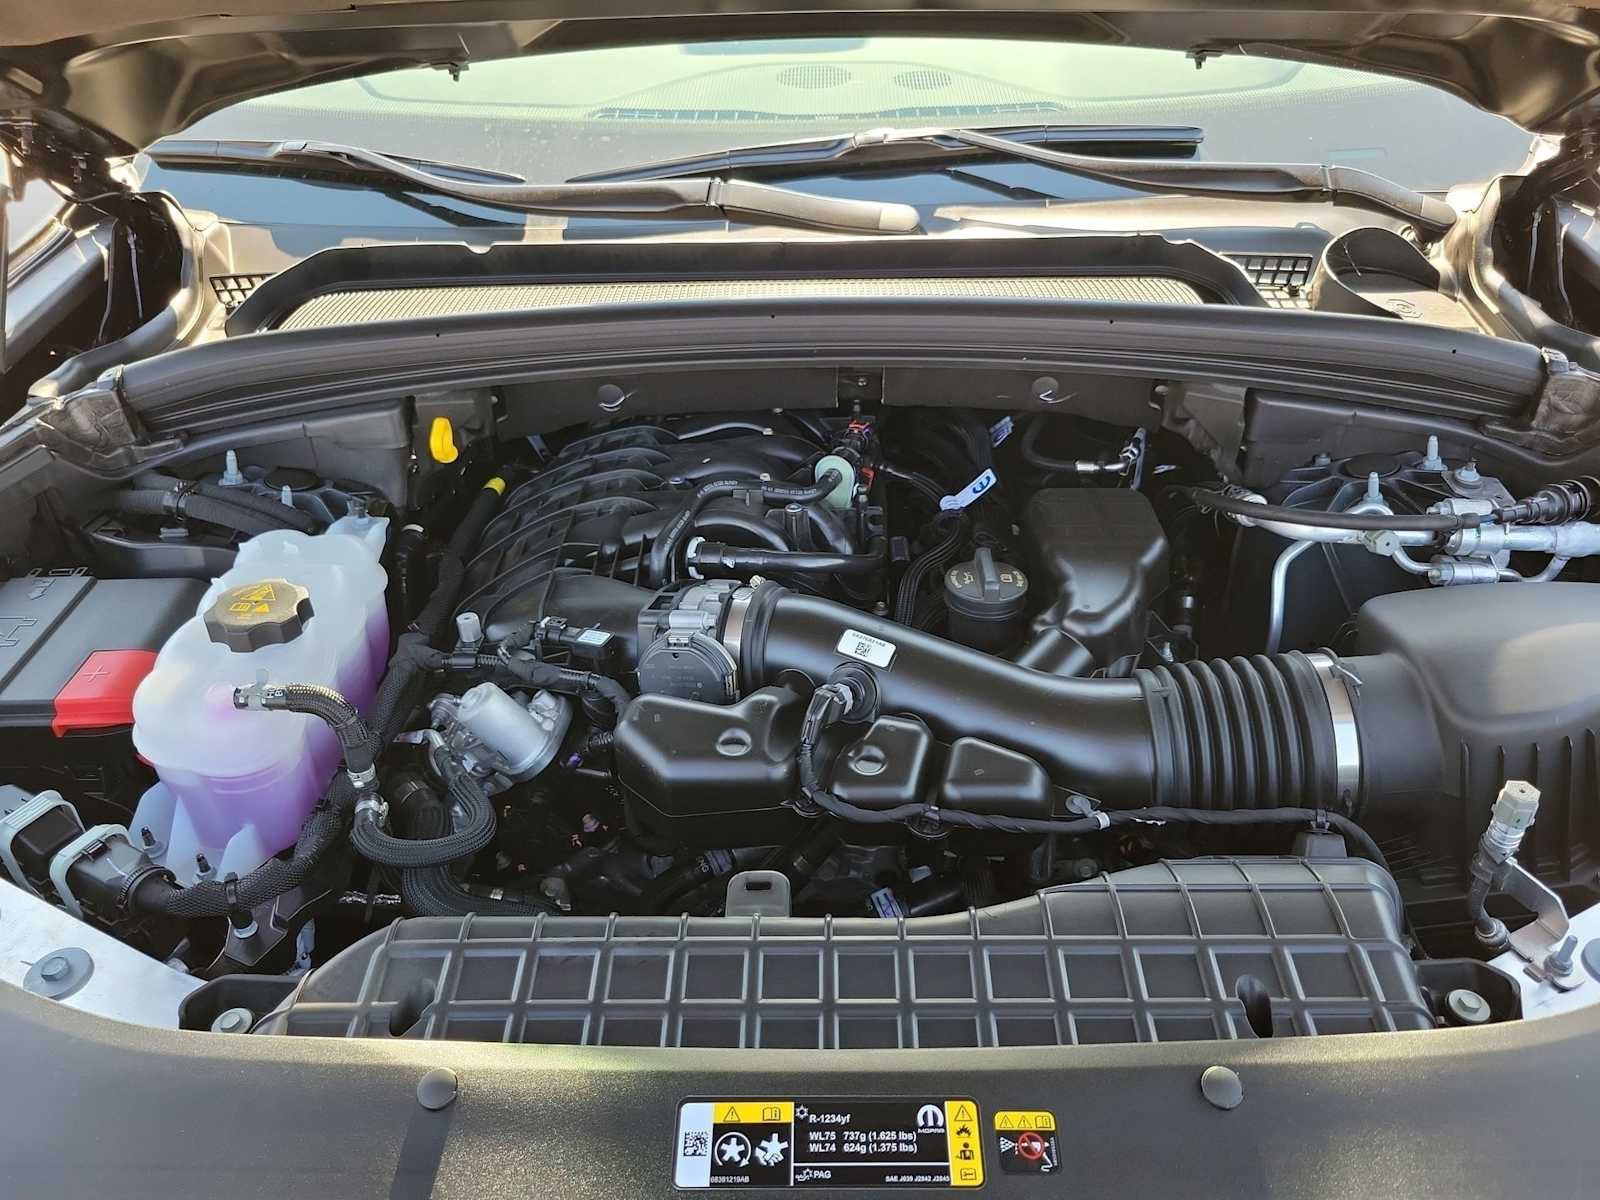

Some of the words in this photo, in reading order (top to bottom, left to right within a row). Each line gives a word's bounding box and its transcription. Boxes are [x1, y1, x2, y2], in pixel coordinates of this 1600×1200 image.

[809, 1114, 851, 1125] R-1234yf
[809, 1132, 836, 1141] WL75
[843, 1132, 867, 1143] 737g
[868, 1131, 897, 1143] (1.625
[899, 1131, 917, 1142] lbs)
[809, 1143, 836, 1153] WL74
[843, 1143, 867, 1154] 624g
[868, 1143, 898, 1154] (1.375
[899, 1143, 918, 1154] lbs)
[813, 1170, 832, 1179] PAG
